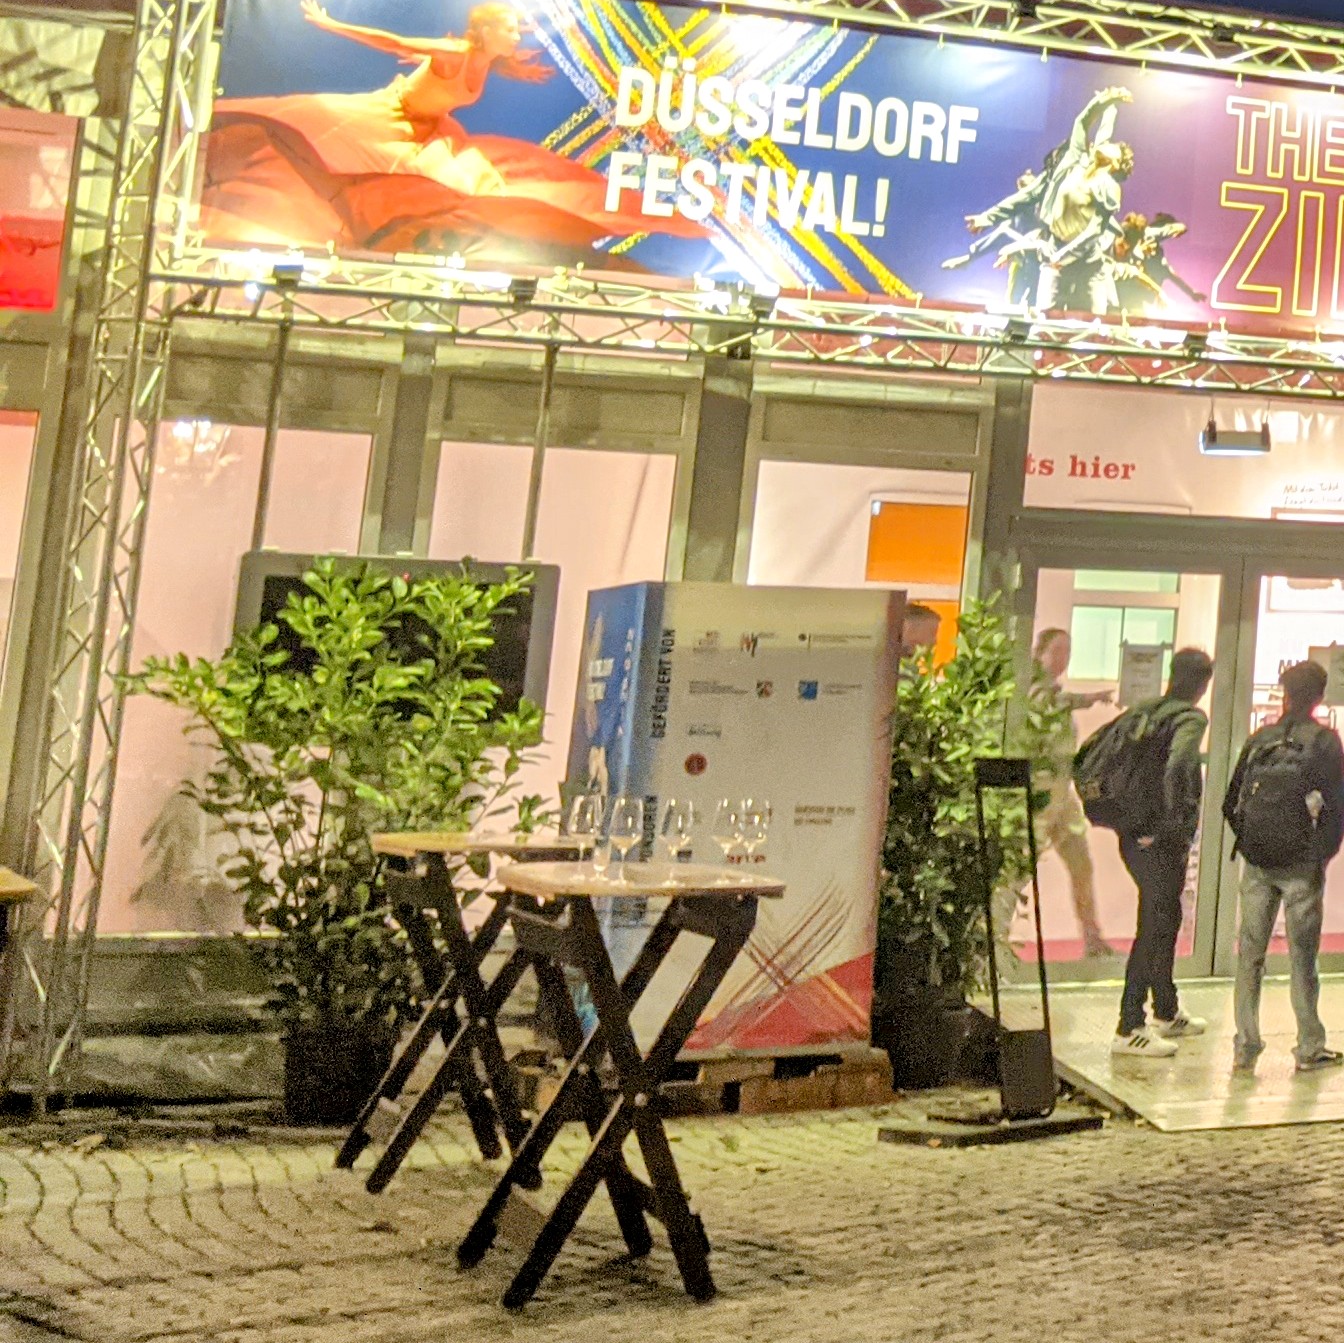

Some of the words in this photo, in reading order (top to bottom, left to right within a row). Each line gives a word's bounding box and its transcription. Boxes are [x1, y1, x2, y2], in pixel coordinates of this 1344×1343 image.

[615, 55, 979, 164] DÜSSELDORF
[604, 151, 890, 237] FESTIVAL!
[1067, 454, 1136, 480] hier
